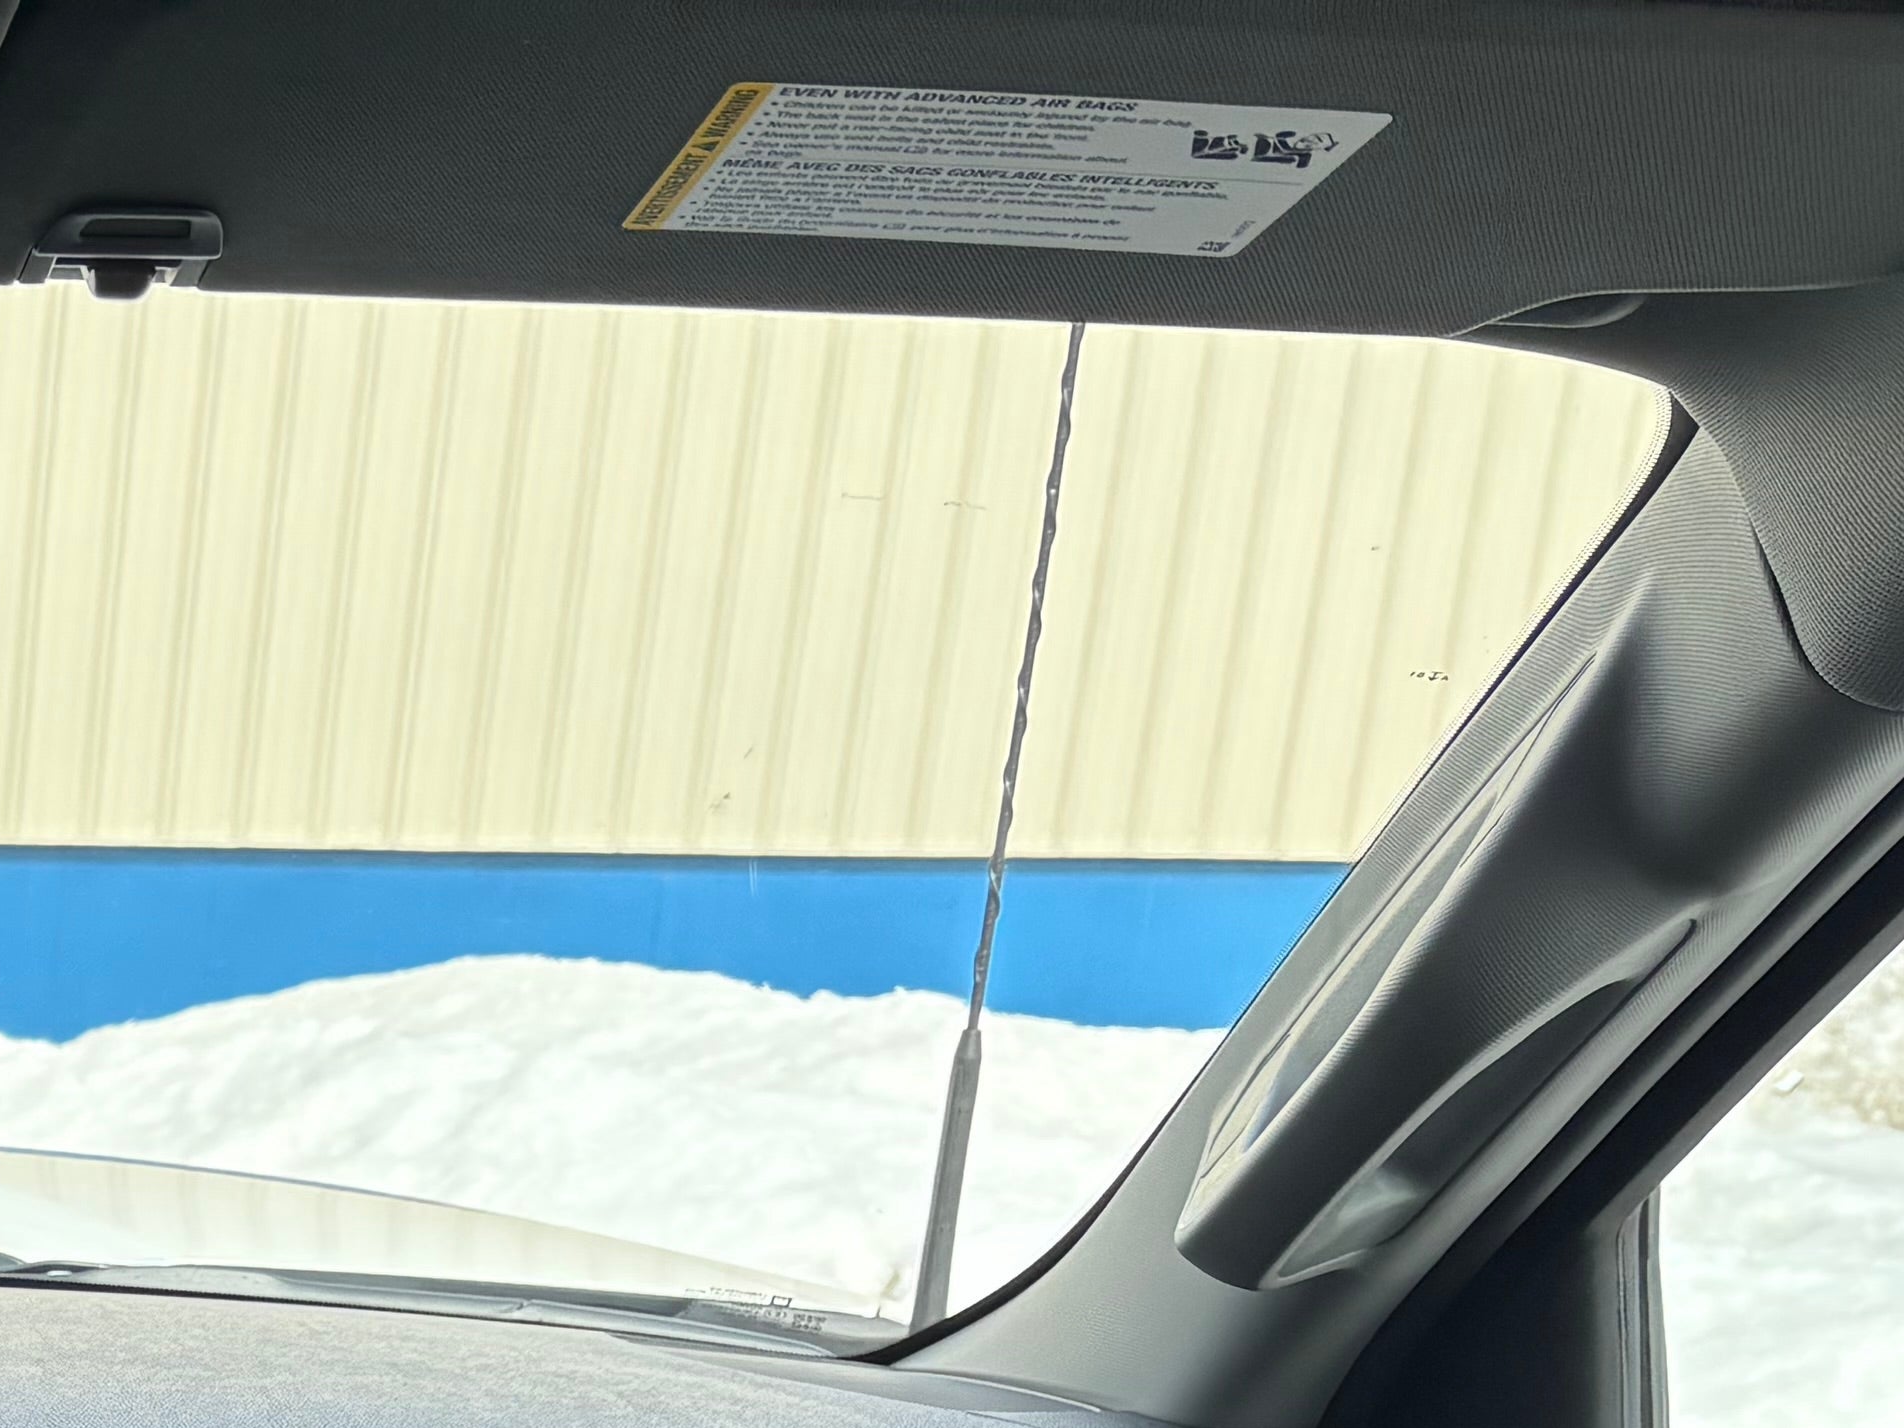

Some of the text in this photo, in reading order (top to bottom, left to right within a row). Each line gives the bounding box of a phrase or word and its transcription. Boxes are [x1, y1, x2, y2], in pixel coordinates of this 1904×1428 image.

[779, 87, 1138, 112] EVEN WITH ADVANCED AIR BAGS
[787, 161, 841, 172] AVEC
[844, 163, 885, 173] DES
[889, 165, 943, 176] SACS
[1079, 173, 1220, 190] INTELLIGENTS
